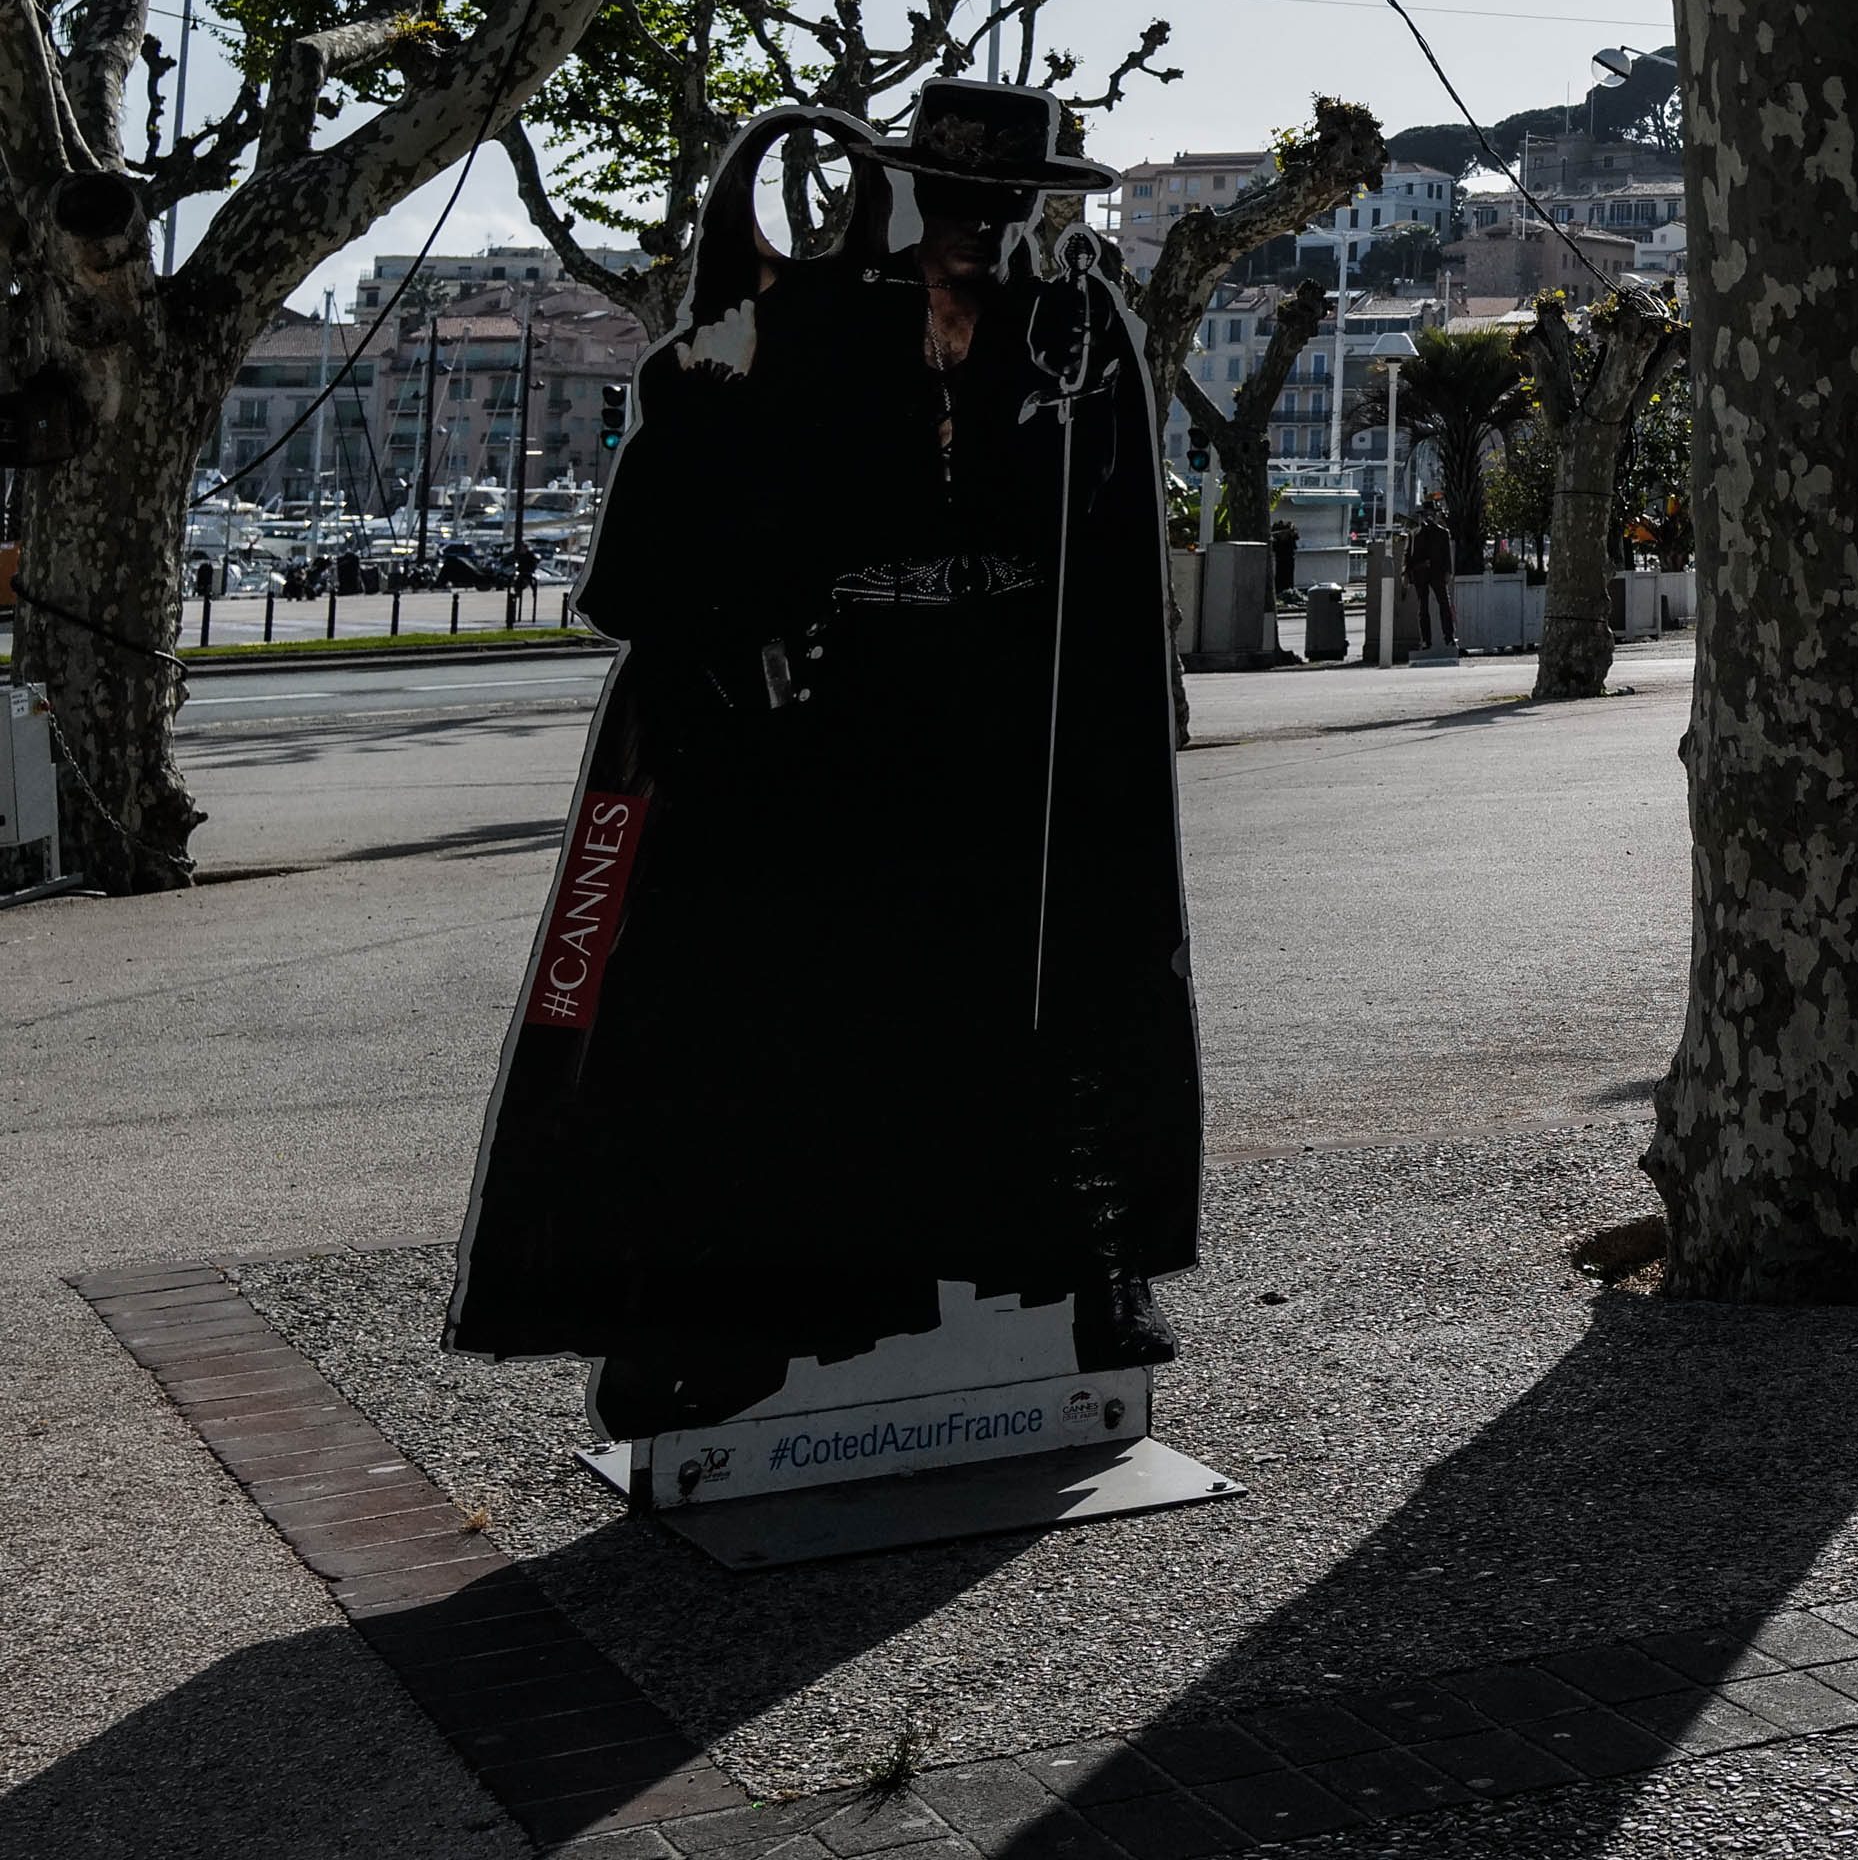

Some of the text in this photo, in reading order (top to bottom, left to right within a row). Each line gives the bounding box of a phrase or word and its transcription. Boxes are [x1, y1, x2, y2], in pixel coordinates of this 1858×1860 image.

[541, 801, 630, 1017] #CANNES
[769, 1408, 1043, 1470] #CotedAzurFrance
[1063, 1402, 1099, 1414] CANNES
